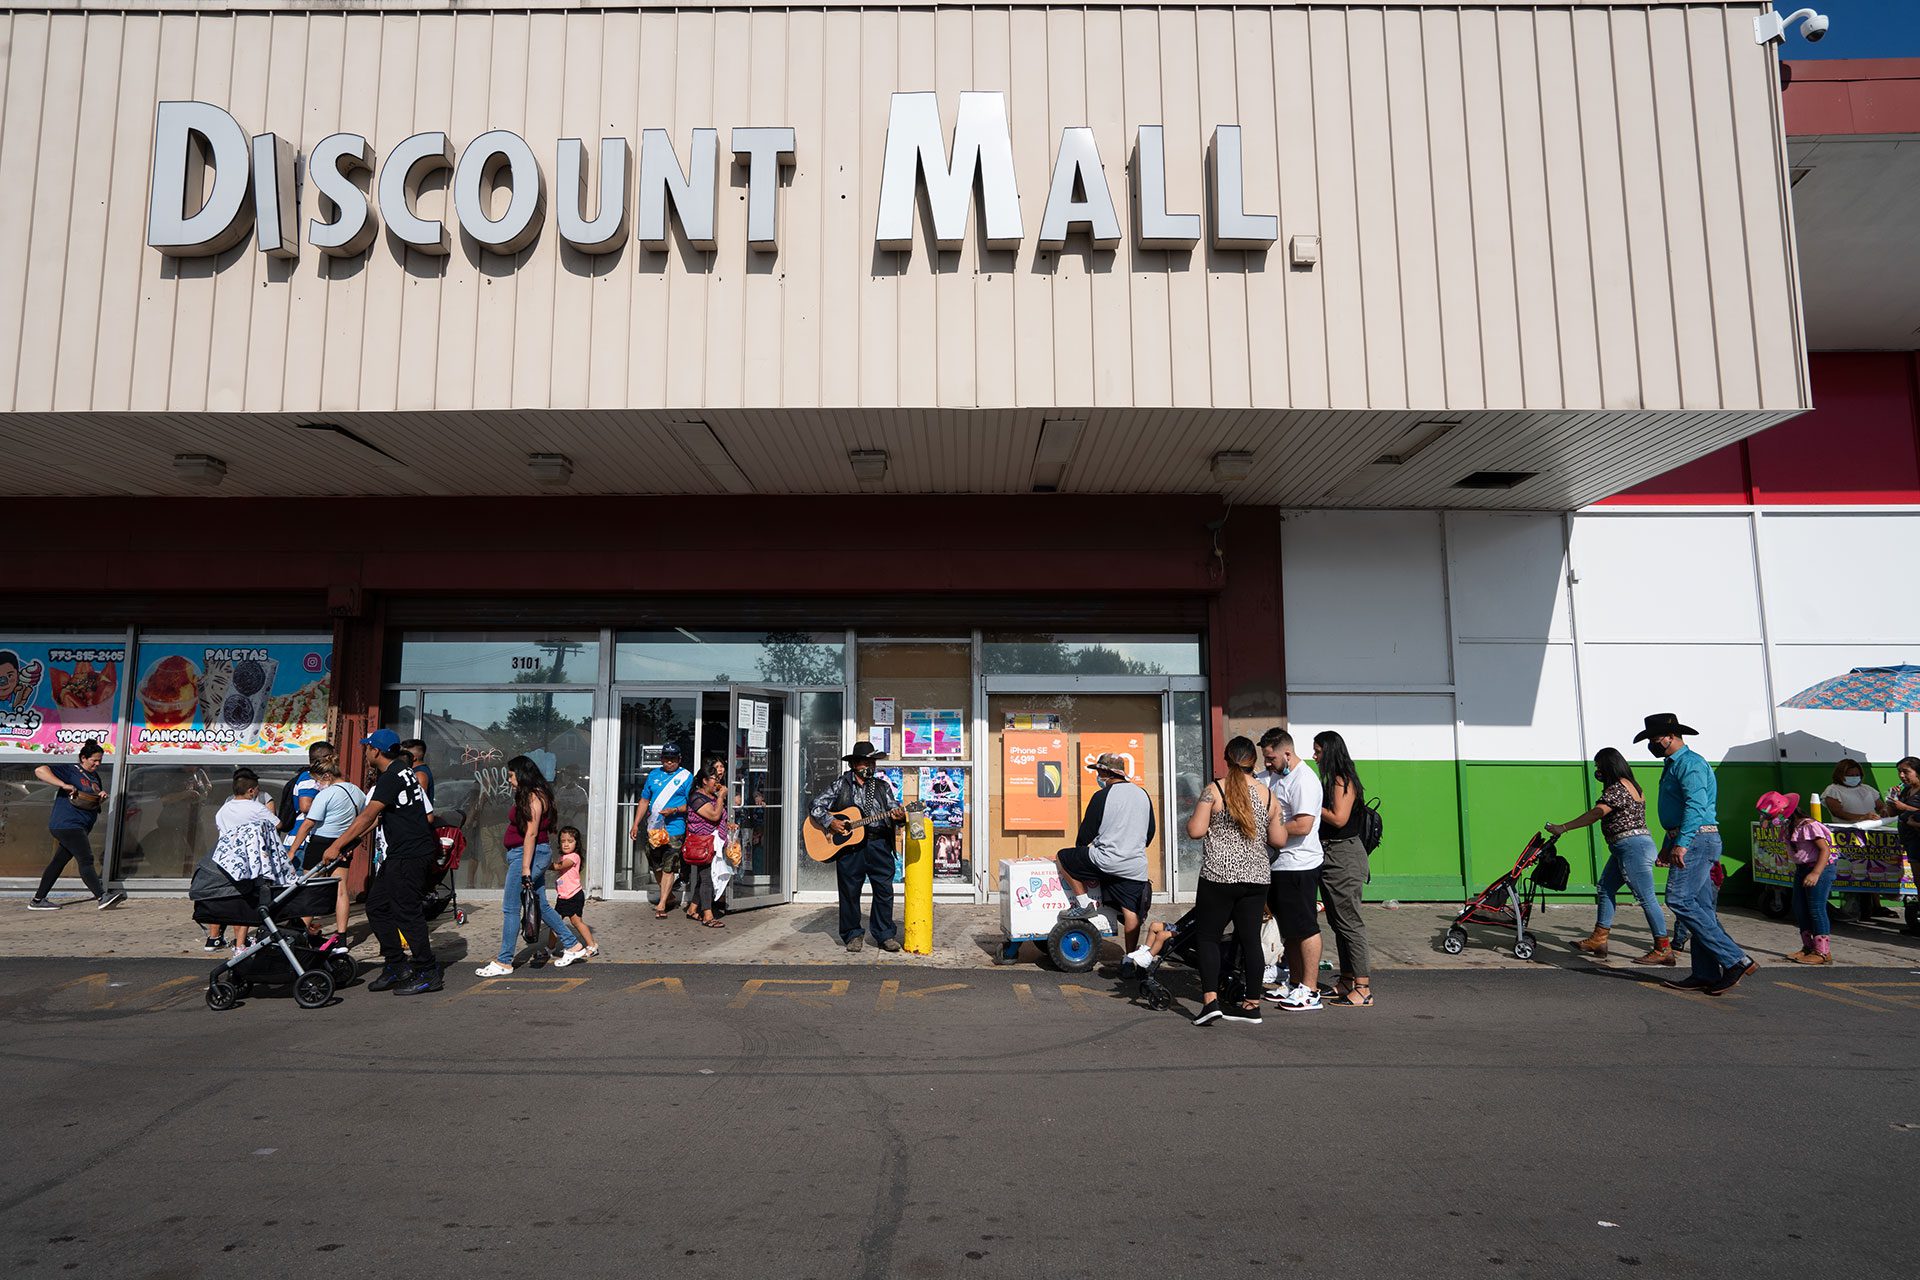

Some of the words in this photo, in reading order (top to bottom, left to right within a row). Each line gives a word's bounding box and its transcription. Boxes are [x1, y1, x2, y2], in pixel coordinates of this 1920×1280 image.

[148, 100, 795, 256] DISCOUNT
[876, 90, 1277, 249] MALL
[204, 648, 268, 662] PALETAS
[511, 656, 541, 670] 3101
[56, 729, 109, 743] YOGURT
[138, 728, 236, 743] MANGONADAS
[1009, 746, 1036, 755] iPhone
[1037, 746, 1048, 755] SE
[1083, 752, 1135, 782] $0
